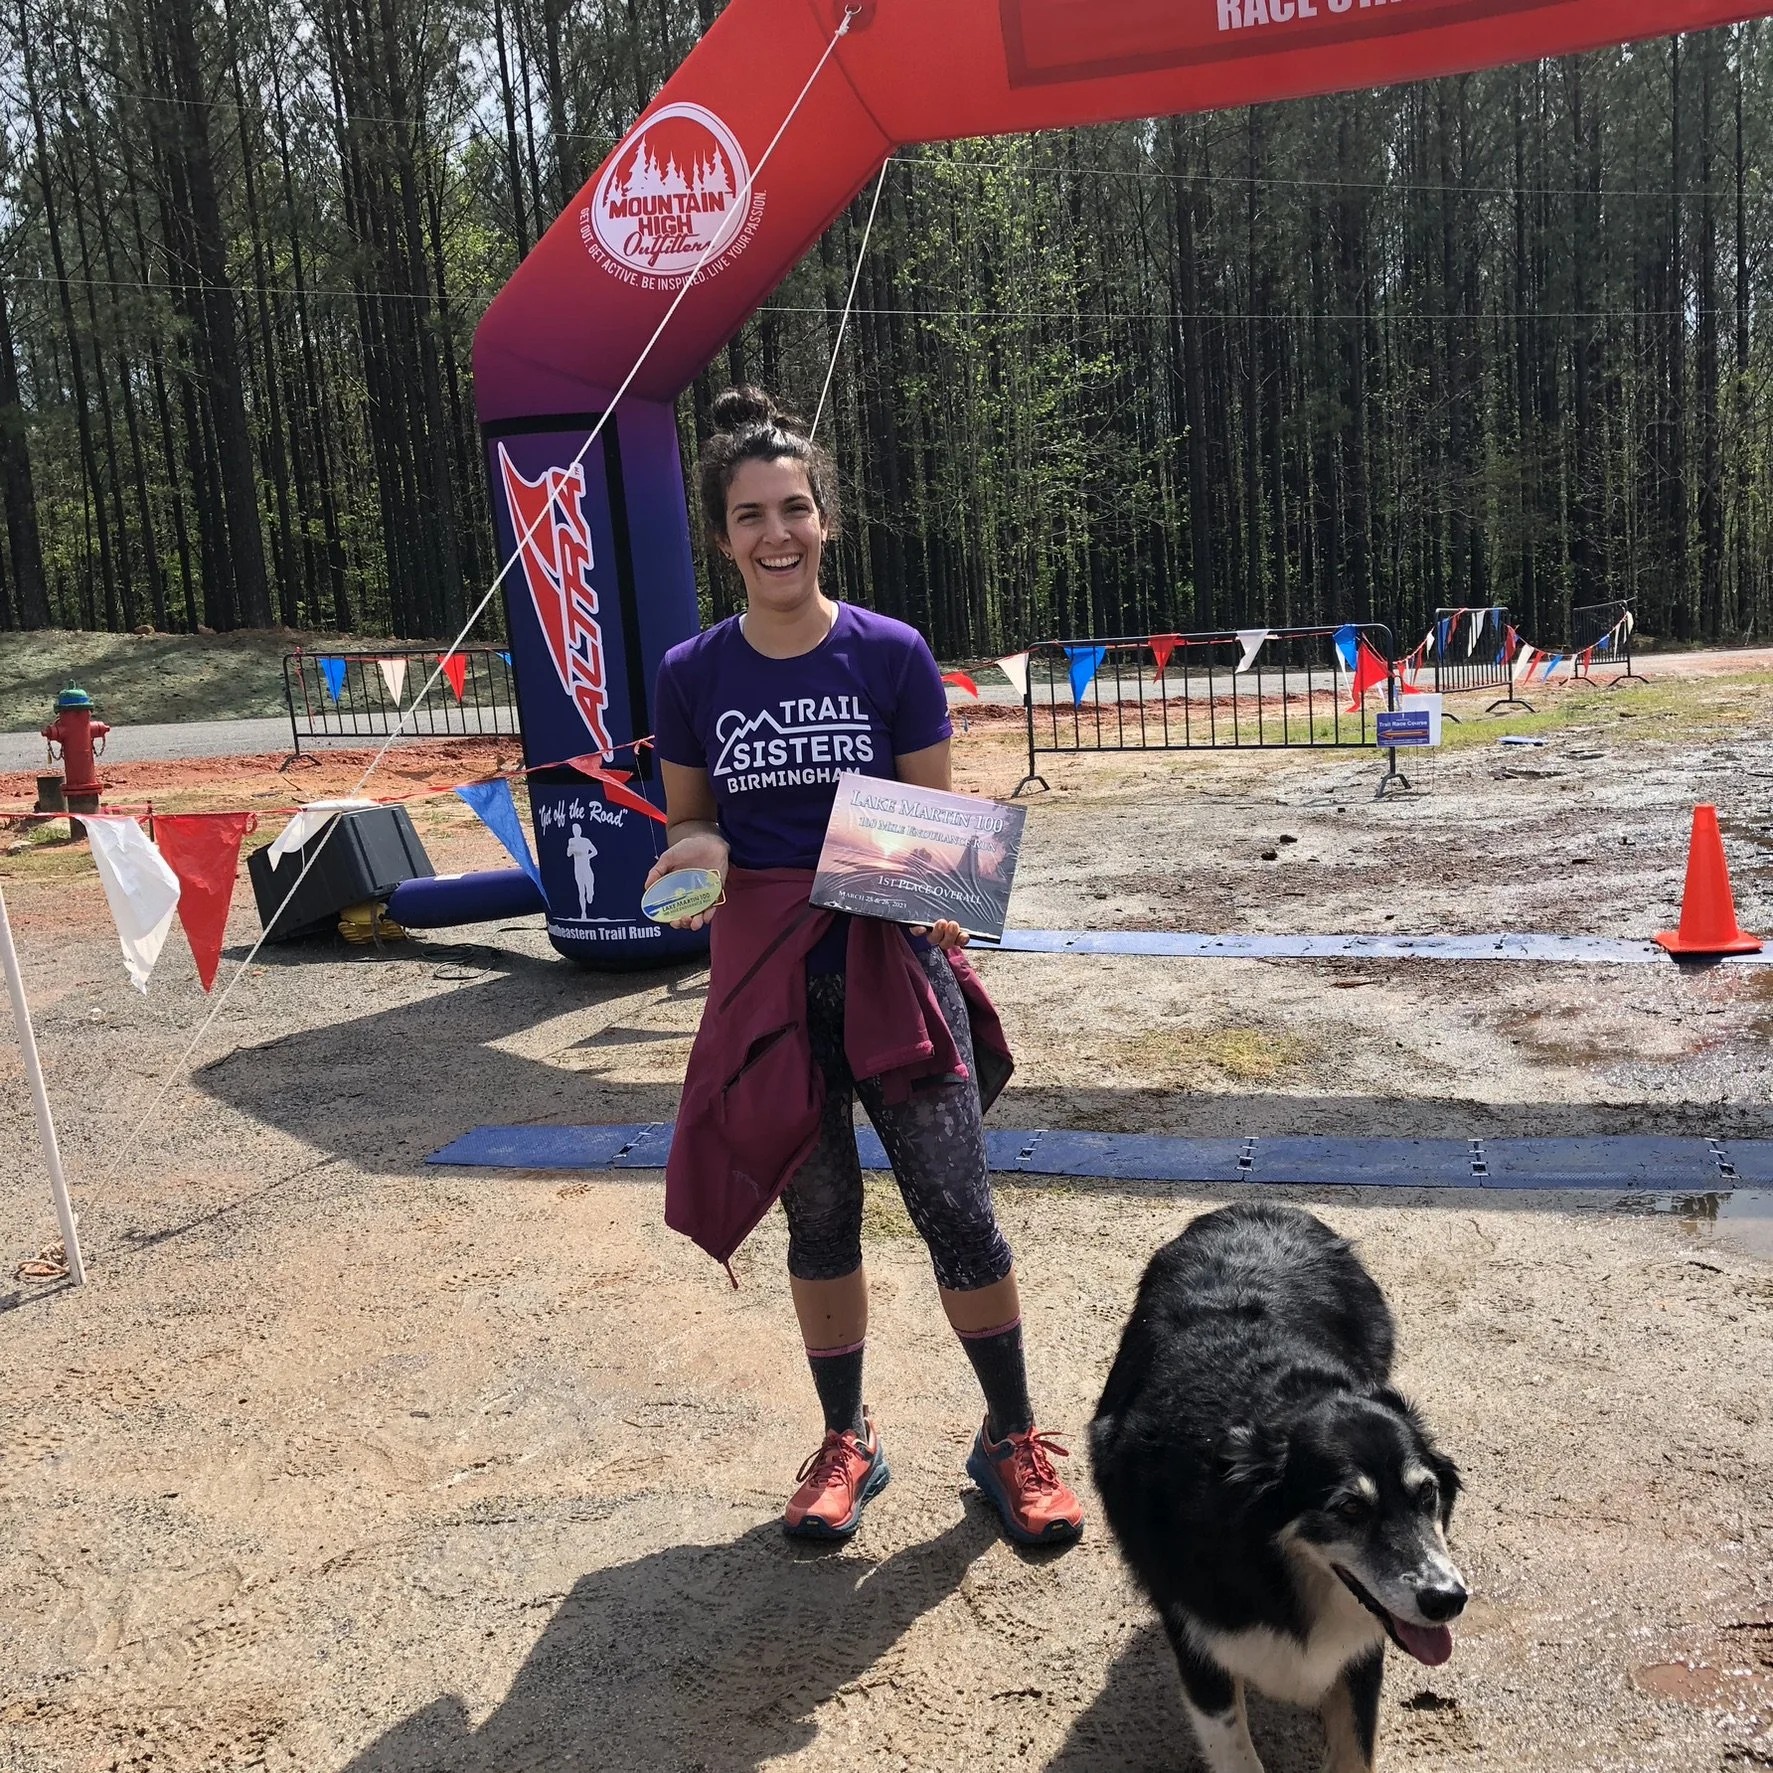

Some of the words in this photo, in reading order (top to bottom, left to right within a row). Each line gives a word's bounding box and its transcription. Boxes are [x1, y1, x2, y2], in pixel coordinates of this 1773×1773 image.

[580, 207, 589, 225] GET
[609, 191, 725, 219] MOUNTAIN
[744, 189, 767, 236] PASSION.
[580, 224, 594, 248] OUT.
[638, 214, 693, 237] HIGH
[588, 243, 606, 263] GET
[623, 231, 715, 267] Outfitters
[727, 234, 752, 259] YOUR
[601, 259, 639, 287] ACTIVE.
[707, 256, 730, 278] LIVE
[641, 276, 655, 290] BE
[549, 467, 612, 762] ALTRA
[779, 695, 869, 724] TRAIL
[732, 734, 874, 771] SISTERS
[553, 799, 566, 828] off
[569, 797, 585, 820] the
[851, 789, 896, 813] LAKE
[899, 800, 971, 828] MARTIN
[974, 815, 1004, 833] 100
[933, 886, 982, 905] OVERALL
[547, 922, 597, 940] eastern
[598, 926, 626, 941] Trail
[629, 925, 662, 939] Runs
